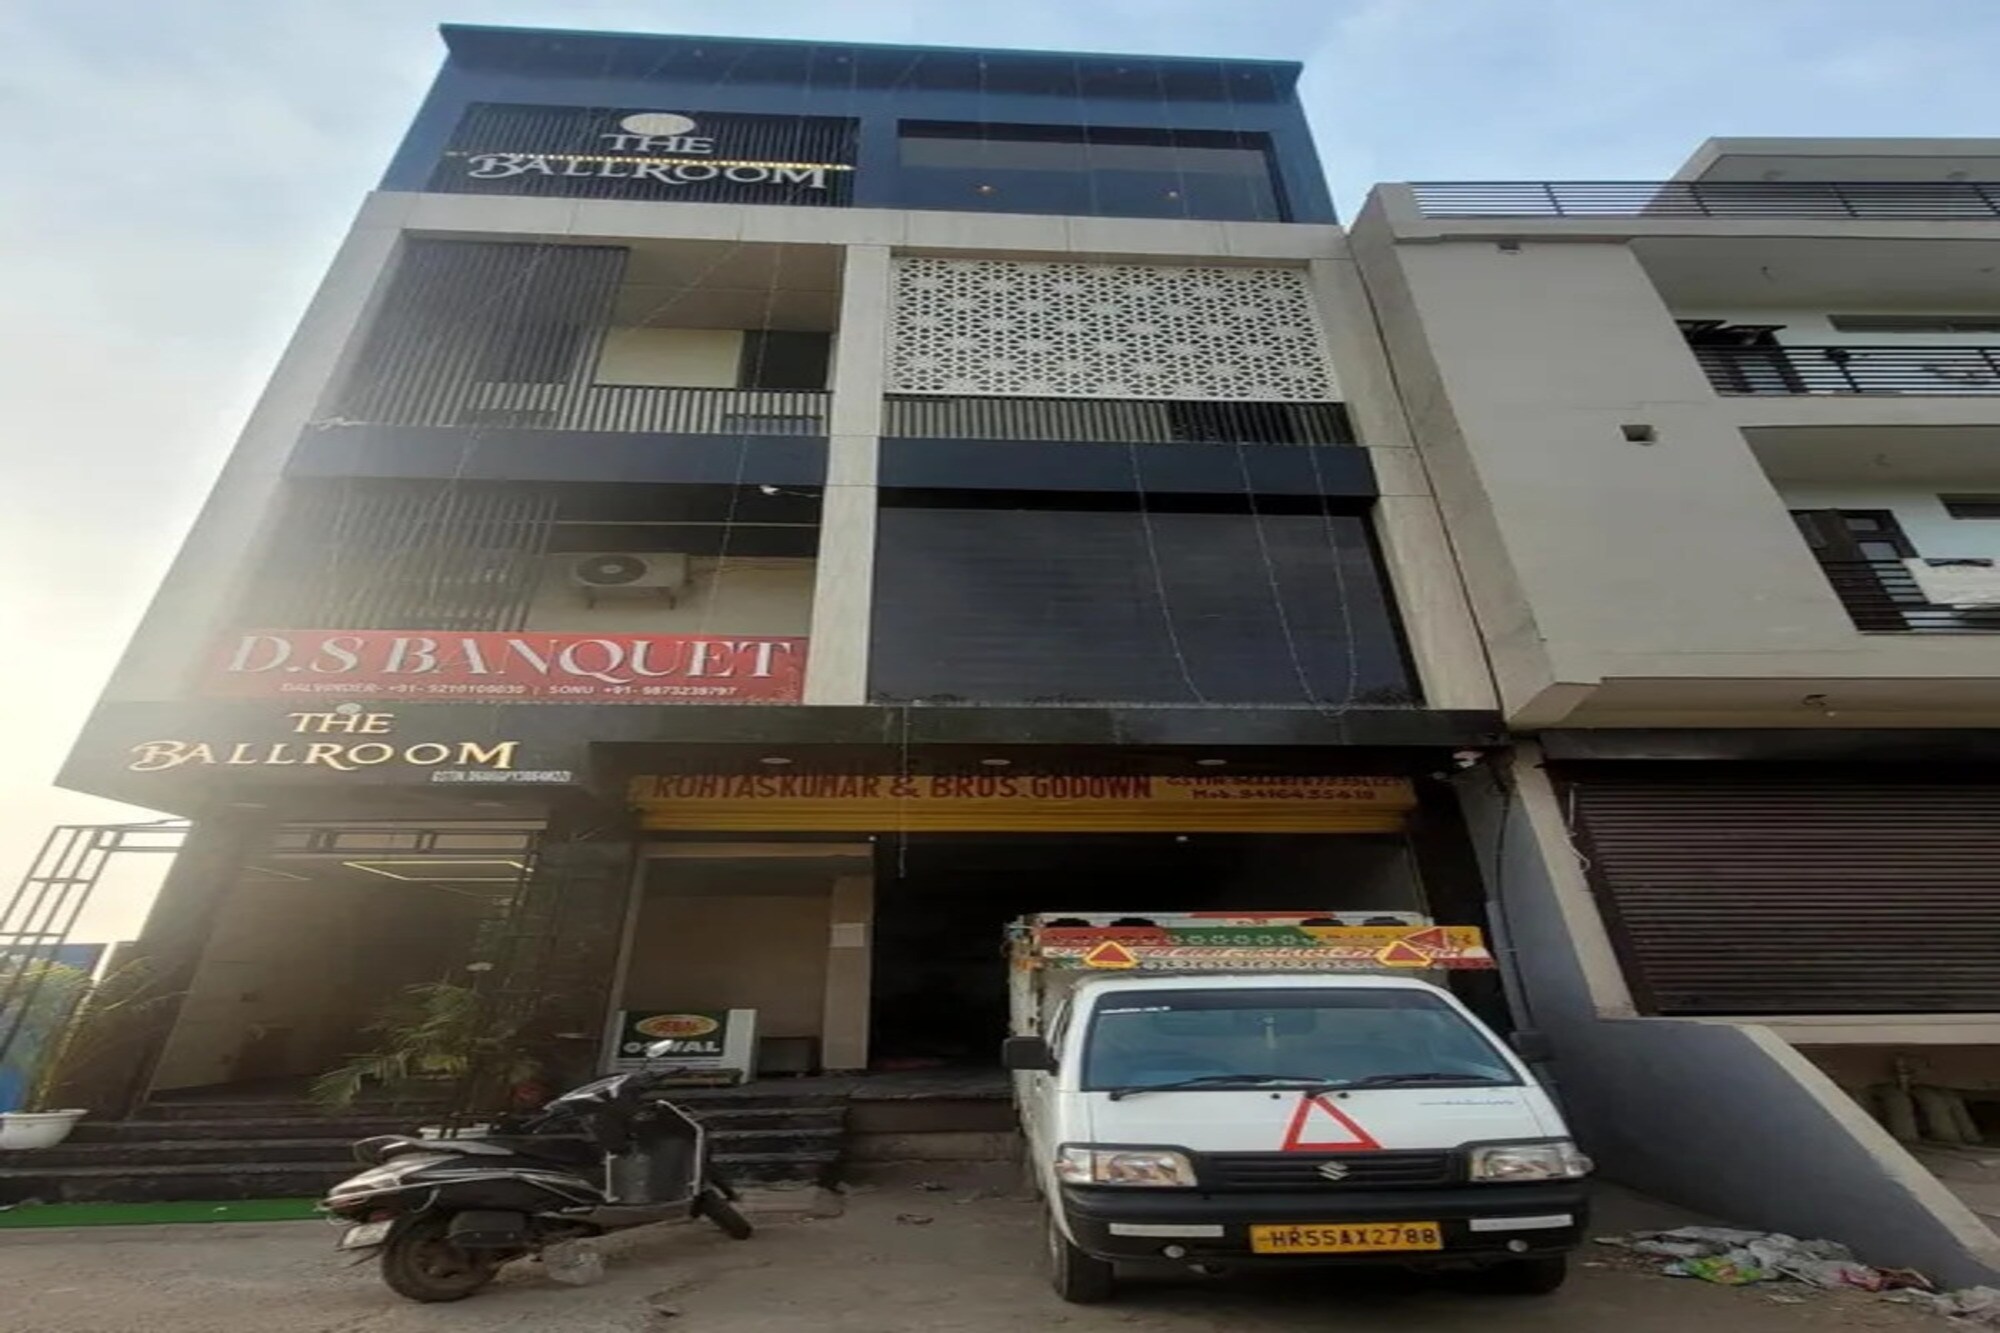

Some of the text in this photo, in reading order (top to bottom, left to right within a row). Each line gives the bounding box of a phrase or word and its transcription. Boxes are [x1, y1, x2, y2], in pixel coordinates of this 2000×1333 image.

[601, 134, 714, 155] THE
[467, 153, 828, 190] BALLROOM
[227, 634, 791, 684] D.S BANQUET
[287, 712, 394, 734] THE
[130, 740, 520, 772] BALLROOM
[889, 774, 921, 799] &
[1269, 1228, 1438, 1247] HR55AX2788
